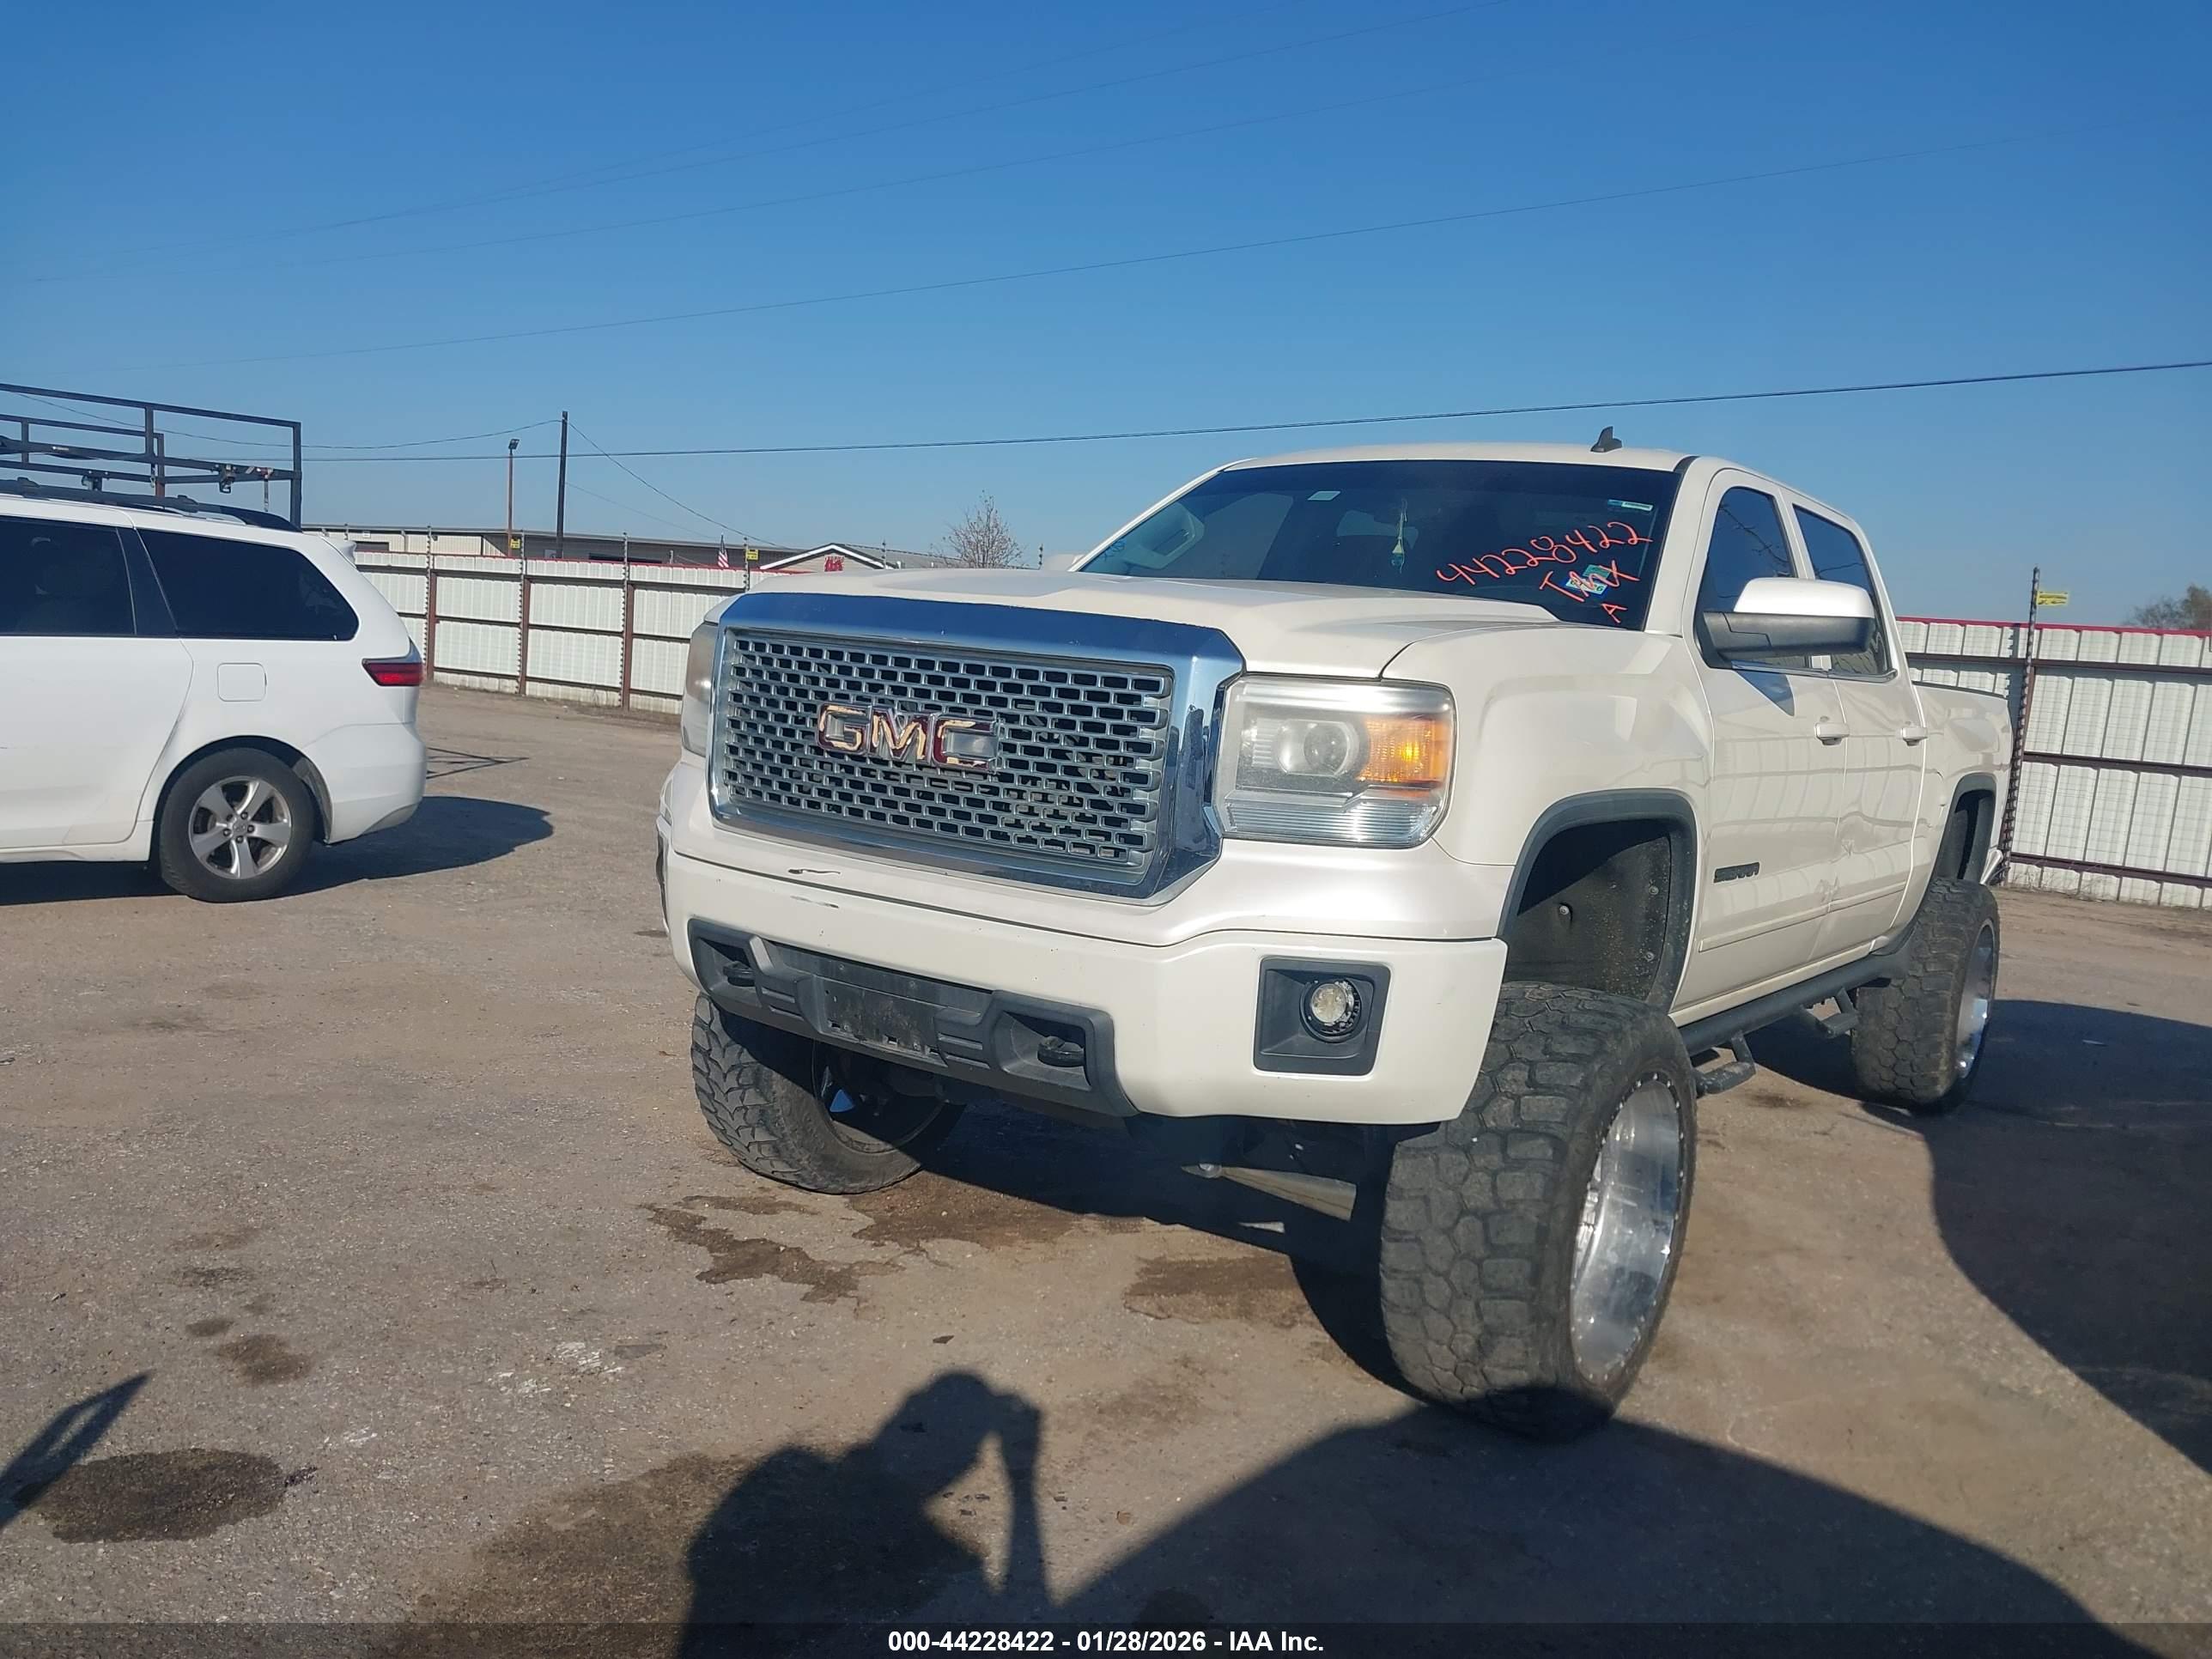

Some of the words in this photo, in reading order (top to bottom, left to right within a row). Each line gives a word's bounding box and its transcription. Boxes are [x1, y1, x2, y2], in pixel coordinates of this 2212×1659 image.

[1437, 521, 1653, 586] 44228422
[1601, 603, 1628, 623] A
[817, 702, 999, 773] GMC
